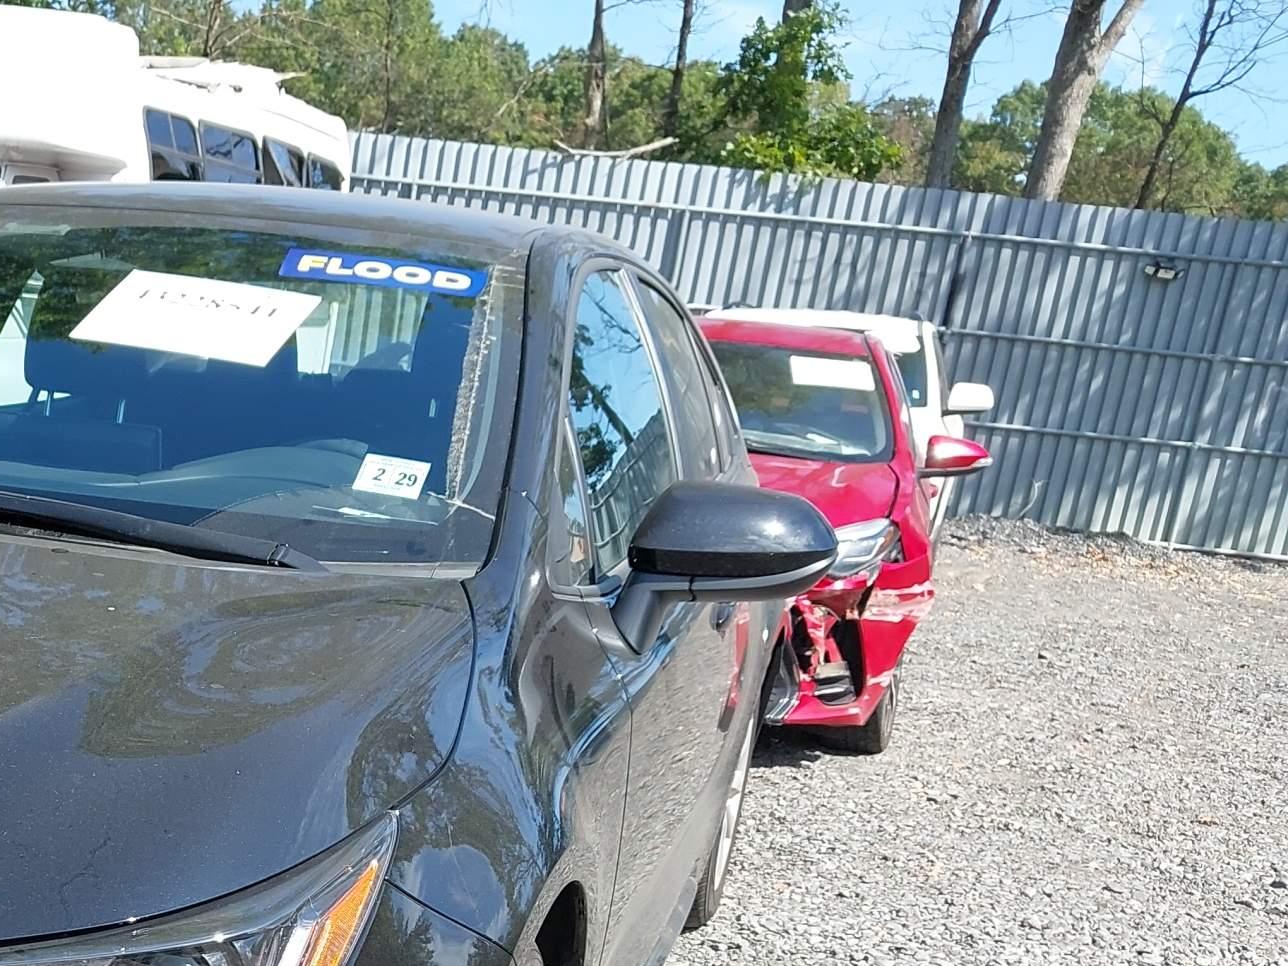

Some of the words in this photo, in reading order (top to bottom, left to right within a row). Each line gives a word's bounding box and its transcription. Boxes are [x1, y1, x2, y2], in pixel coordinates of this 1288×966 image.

[297, 254, 472, 291] FLOOD
[372, 467, 386, 482] 2
[394, 471, 418, 487] 29
